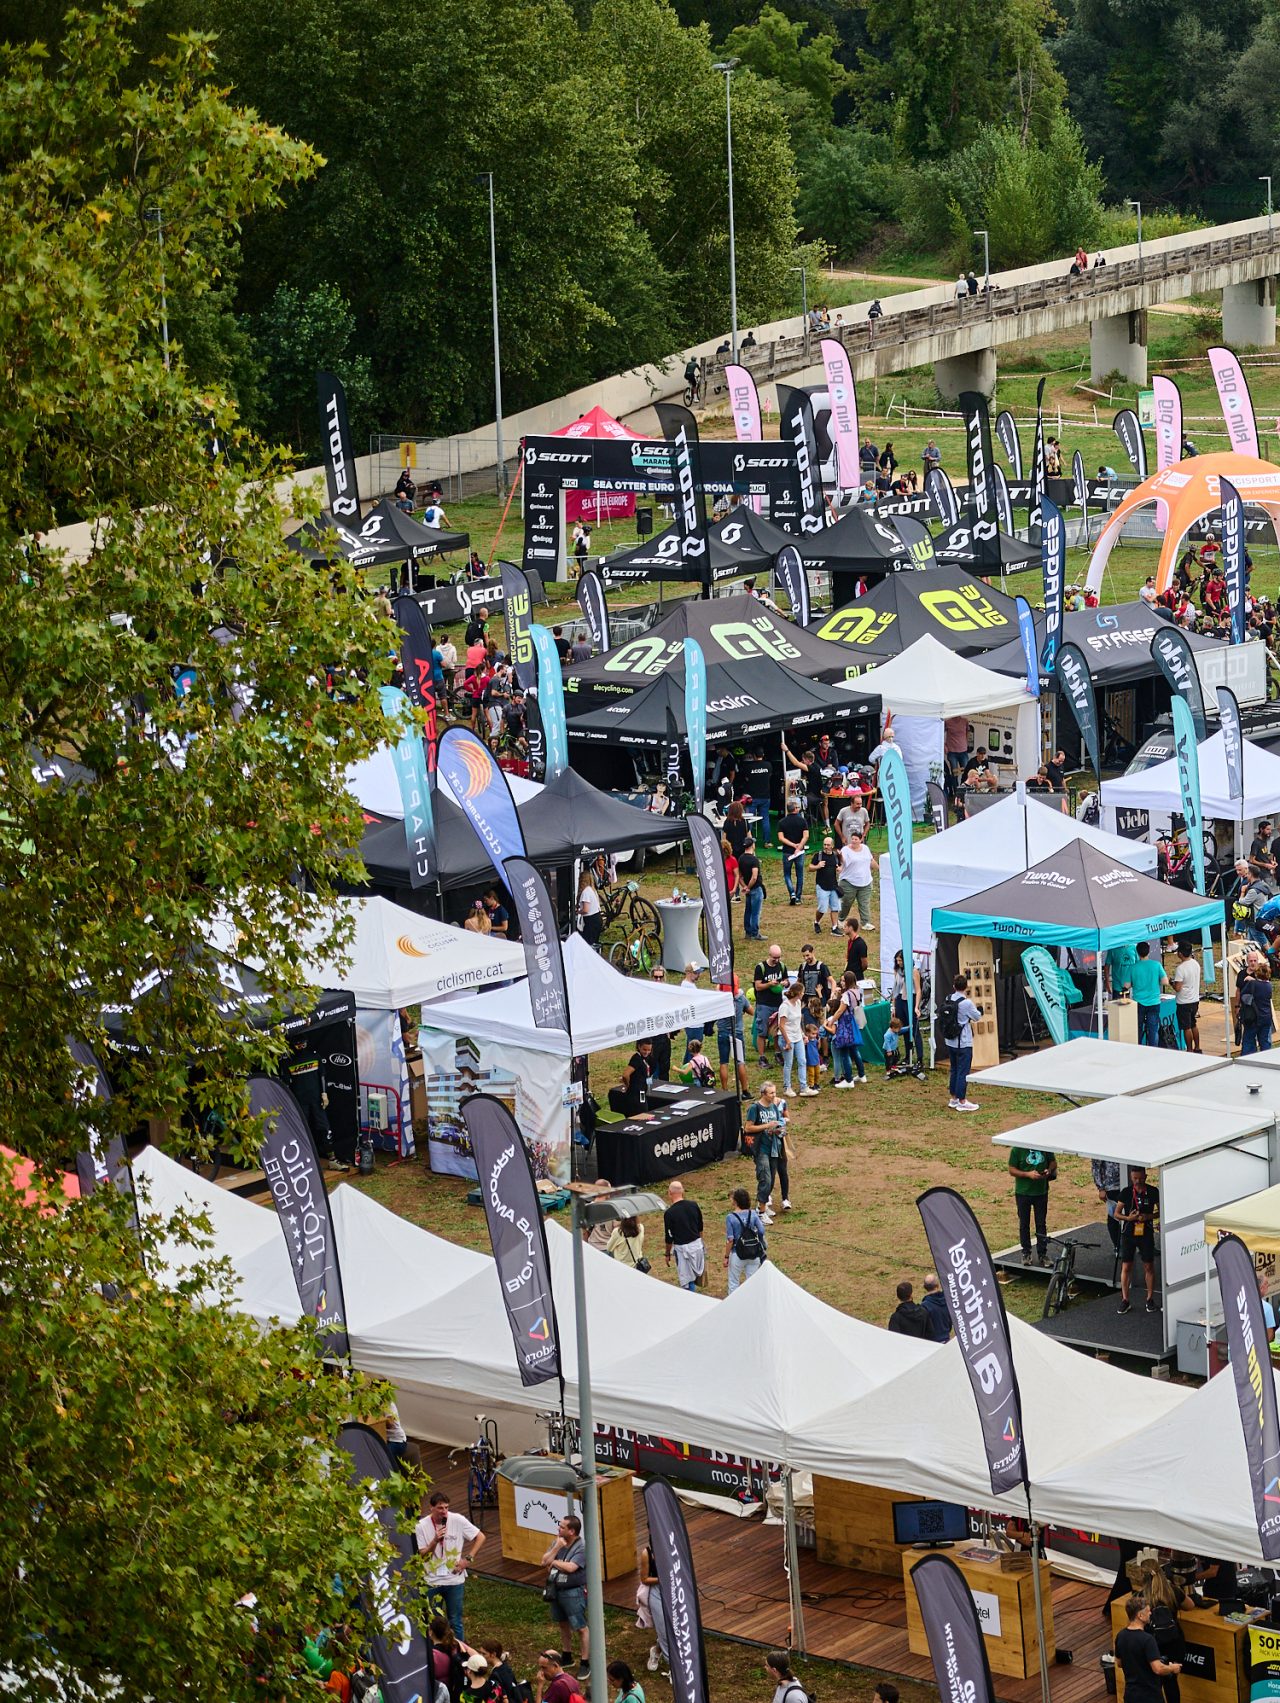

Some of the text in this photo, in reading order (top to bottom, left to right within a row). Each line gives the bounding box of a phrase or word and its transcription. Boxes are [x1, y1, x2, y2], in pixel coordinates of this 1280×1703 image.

[536, 452, 593, 463] SCOTT
[593, 479, 647, 491] SEA OTTER
[581, 497, 592, 510] SEA
[608, 495, 628, 508] EUROPE
[880, 498, 931, 519] SCOTT
[418, 545, 438, 554] SCOTT
[610, 570, 649, 578] SCOTT
[718, 566, 738, 577] SCOTT
[1087, 627, 1157, 650] STAGES
[711, 695, 759, 712] cairn
[437, 962, 504, 991] ciclisme.cat
[676, 1151, 693, 1162] HOTEL
